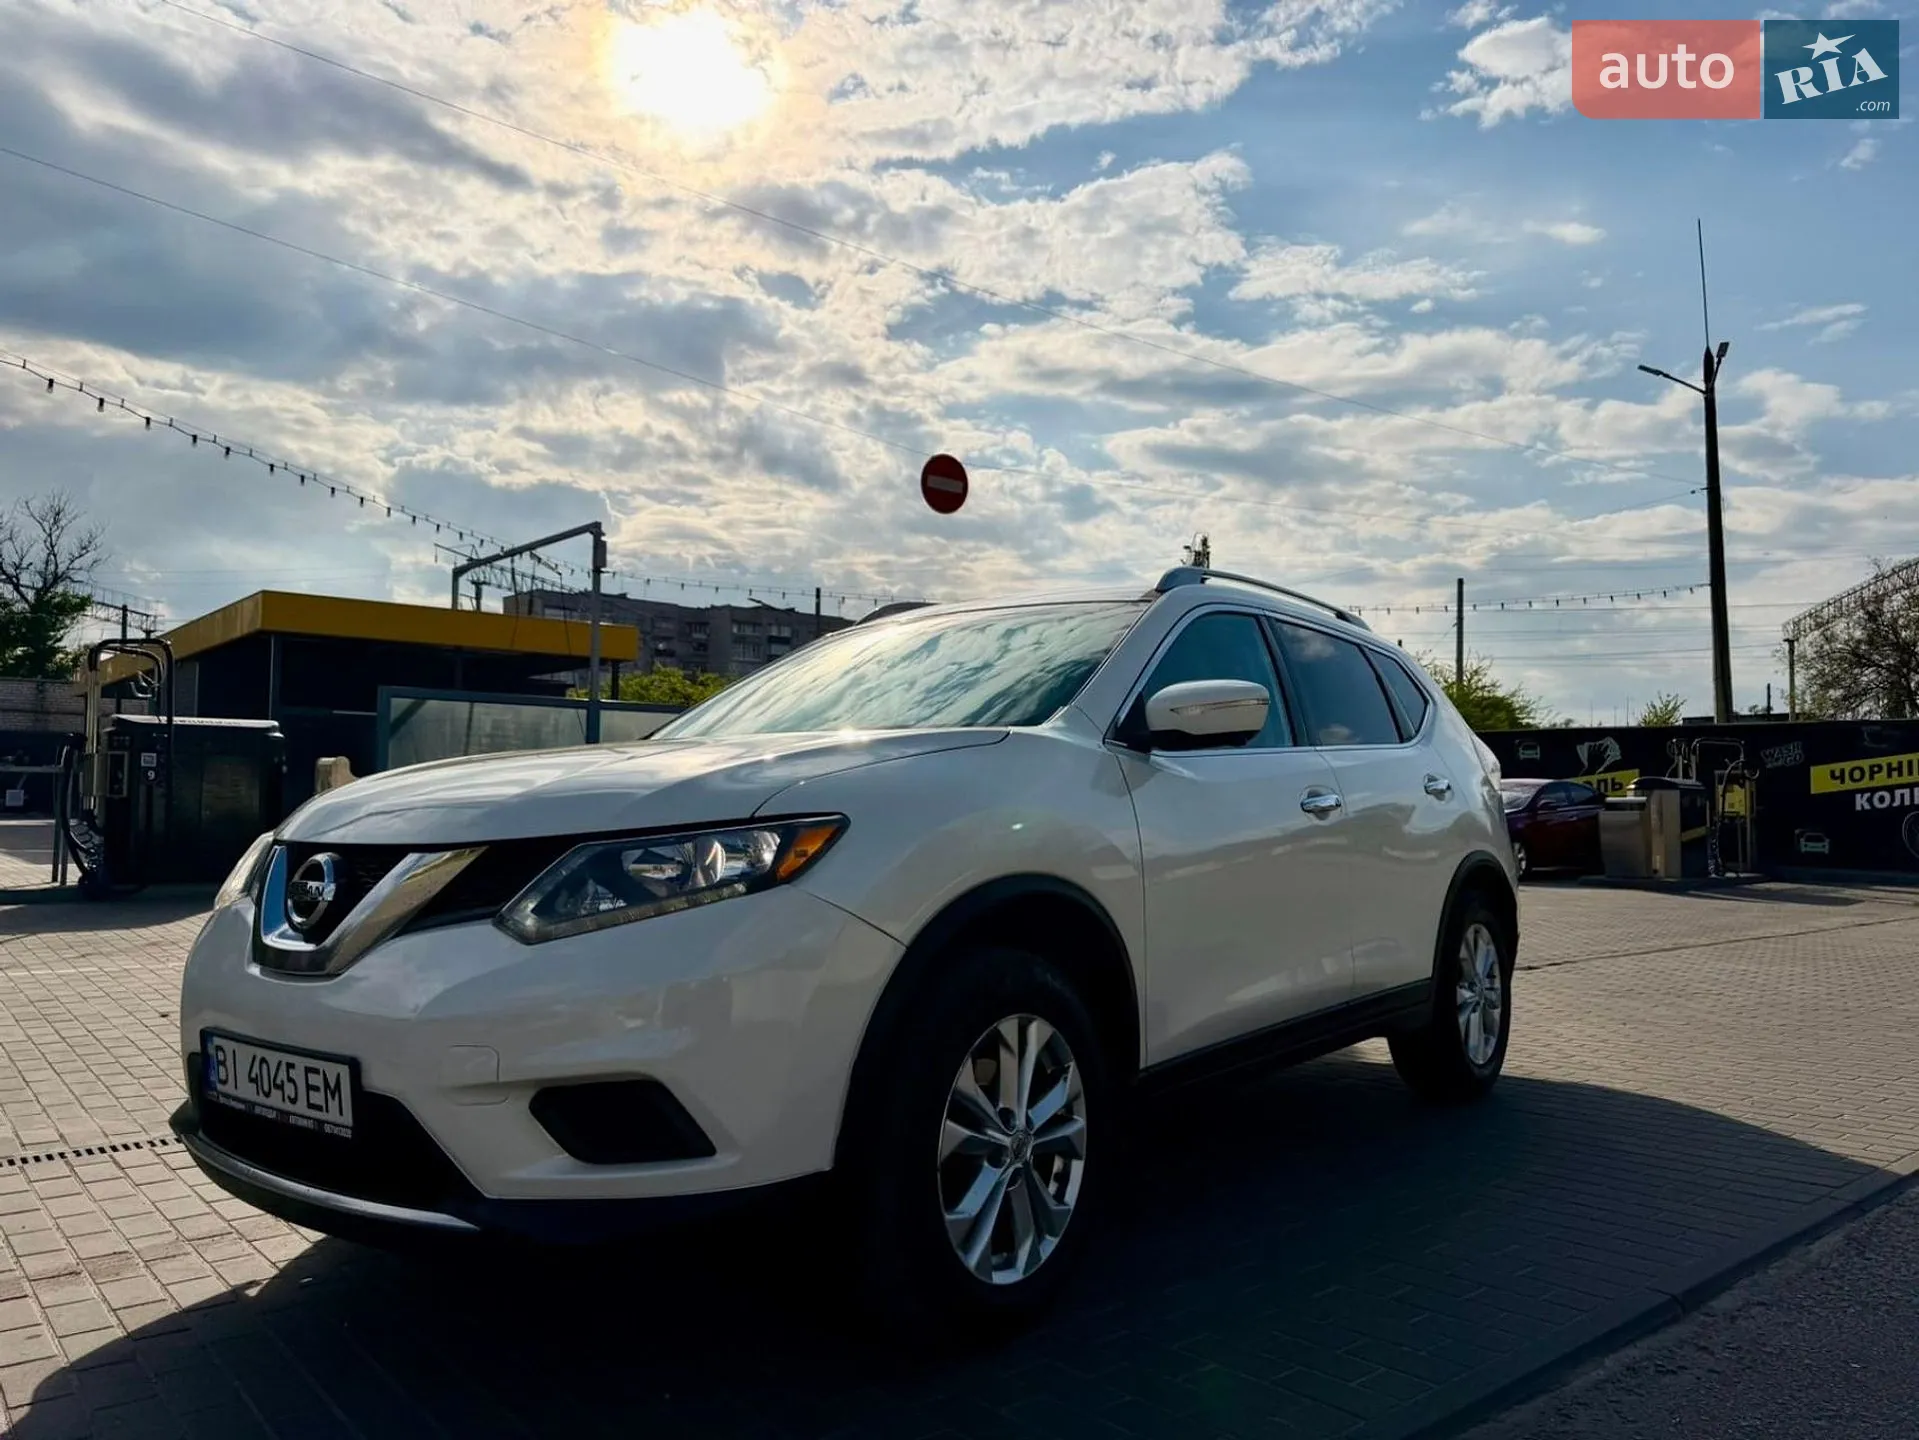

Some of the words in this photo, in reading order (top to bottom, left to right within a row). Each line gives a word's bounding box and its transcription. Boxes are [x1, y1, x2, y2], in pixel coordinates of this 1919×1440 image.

[147, 770, 156, 781] 9
[1830, 759, 1919, 784] ЧОРНІ
[215, 1045, 238, 1090] BI
[248, 1054, 298, 1105] 4045
[304, 1065, 344, 1116] EM
